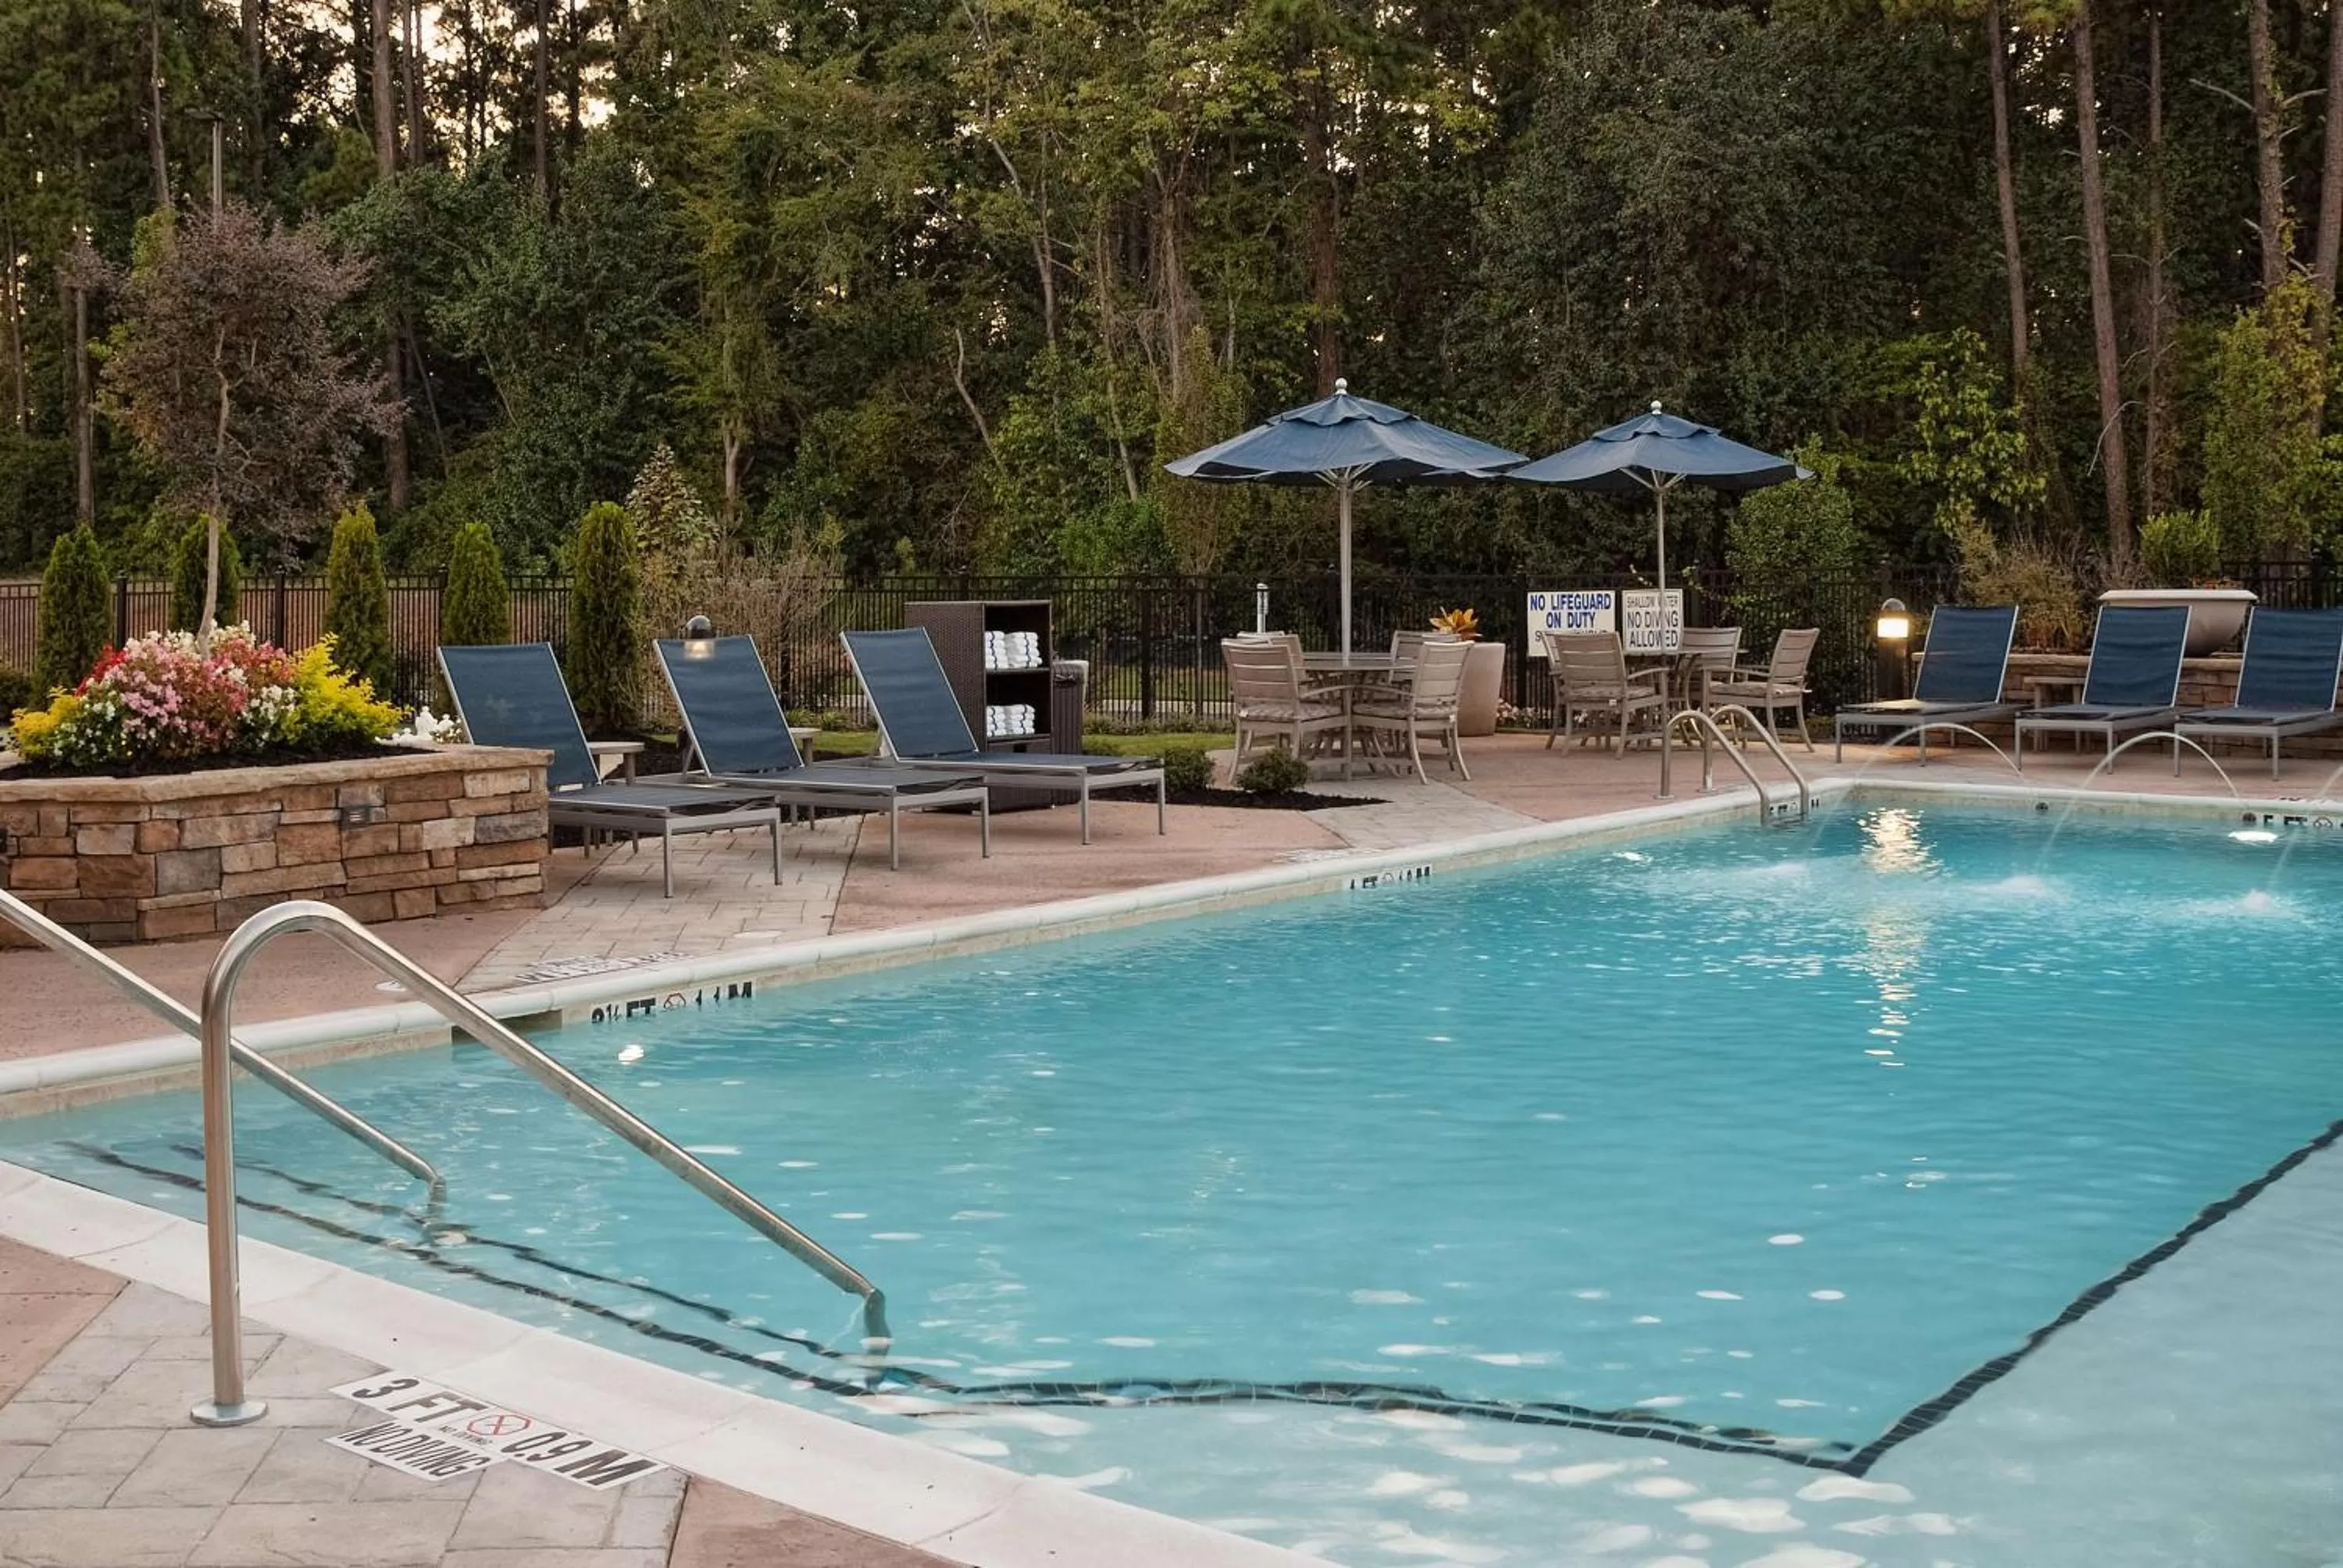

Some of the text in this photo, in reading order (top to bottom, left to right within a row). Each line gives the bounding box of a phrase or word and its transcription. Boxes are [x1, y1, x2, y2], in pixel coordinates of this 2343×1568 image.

[1530, 593, 1611, 611] NO LIFEGUARD
[1657, 596, 1678, 608] WTER
[1546, 611, 1596, 628] ON DUTY
[1627, 611, 1678, 629] NO DIVNG
[337, 1422, 413, 1445] NO
[352, 1378, 419, 1399] 3
[386, 1390, 488, 1423] FT
[501, 1431, 594, 1462] 0.9
[554, 1449, 658, 1486] M
[369, 1434, 491, 1477] DIVING
